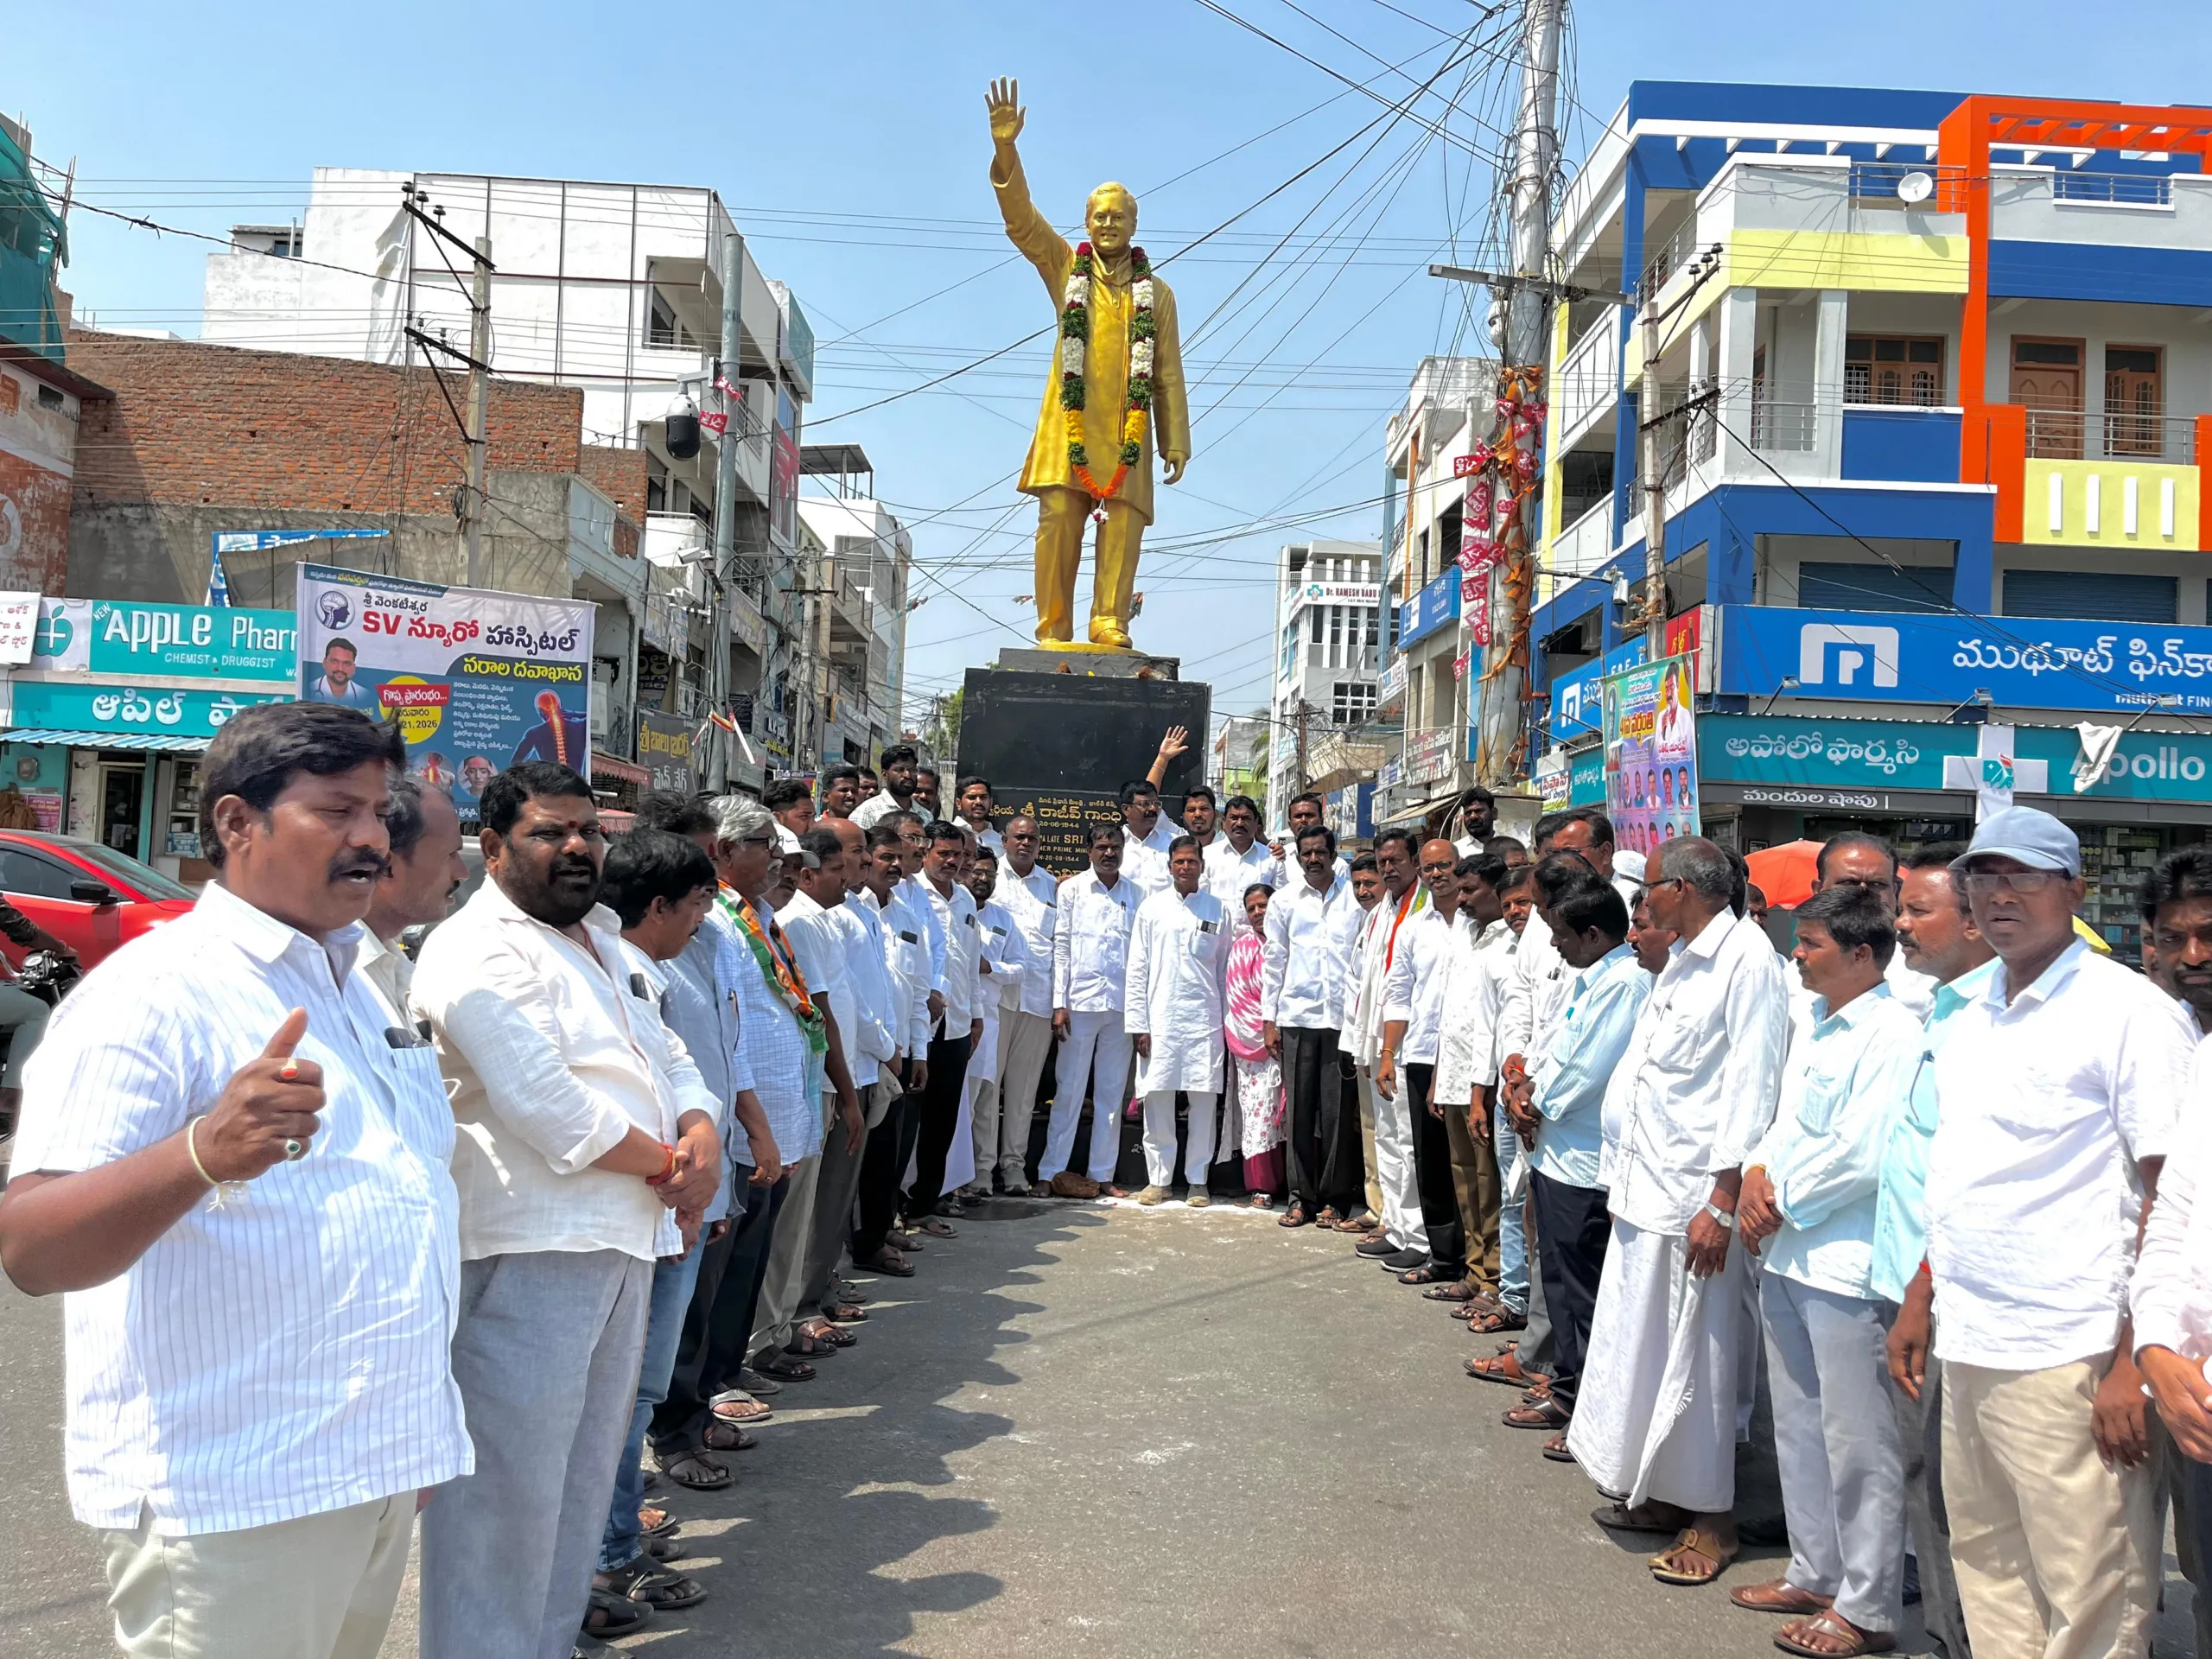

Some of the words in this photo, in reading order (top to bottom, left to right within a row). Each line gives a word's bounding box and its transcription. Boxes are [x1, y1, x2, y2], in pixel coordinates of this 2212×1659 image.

[1325, 588, 1334, 597] Dr.
[1336, 588, 1360, 597] RAMESH
[1361, 588, 1377, 597] BABU
[93, 602, 111, 622] NEW
[363, 591, 372, 607] శ్రీ
[374, 596, 428, 614] వెంకటేశ్వర
[363, 611, 402, 635] SV
[407, 617, 480, 647] న్యూరో
[486, 625, 580, 656] హాస్పిటల్
[164, 652, 209, 664] CHEMIST
[221, 657, 276, 669] DRUGGIST
[463, 657, 510, 677] నరాల
[513, 661, 582, 682] దవాఖాన
[92, 688, 187, 726] ఆపిల్
[384, 690, 404, 705] గొప్ప
[2188, 696, 2212, 707] FIN
[398, 709, 429, 717] రువారం
[416, 720, 438, 729] 2026
[639, 720, 650, 752] శ్రీ
[1726, 731, 1823, 760] అపోలో
[1743, 789, 1824, 804] మందుల
[1828, 792, 1878, 809] షాపు
[1020, 802, 1036, 817] శ్రీ
[1039, 804, 1081, 820] రాజీవ్
[1046, 835, 1060, 843] LATE
[1064, 834, 1084, 844] SRI
